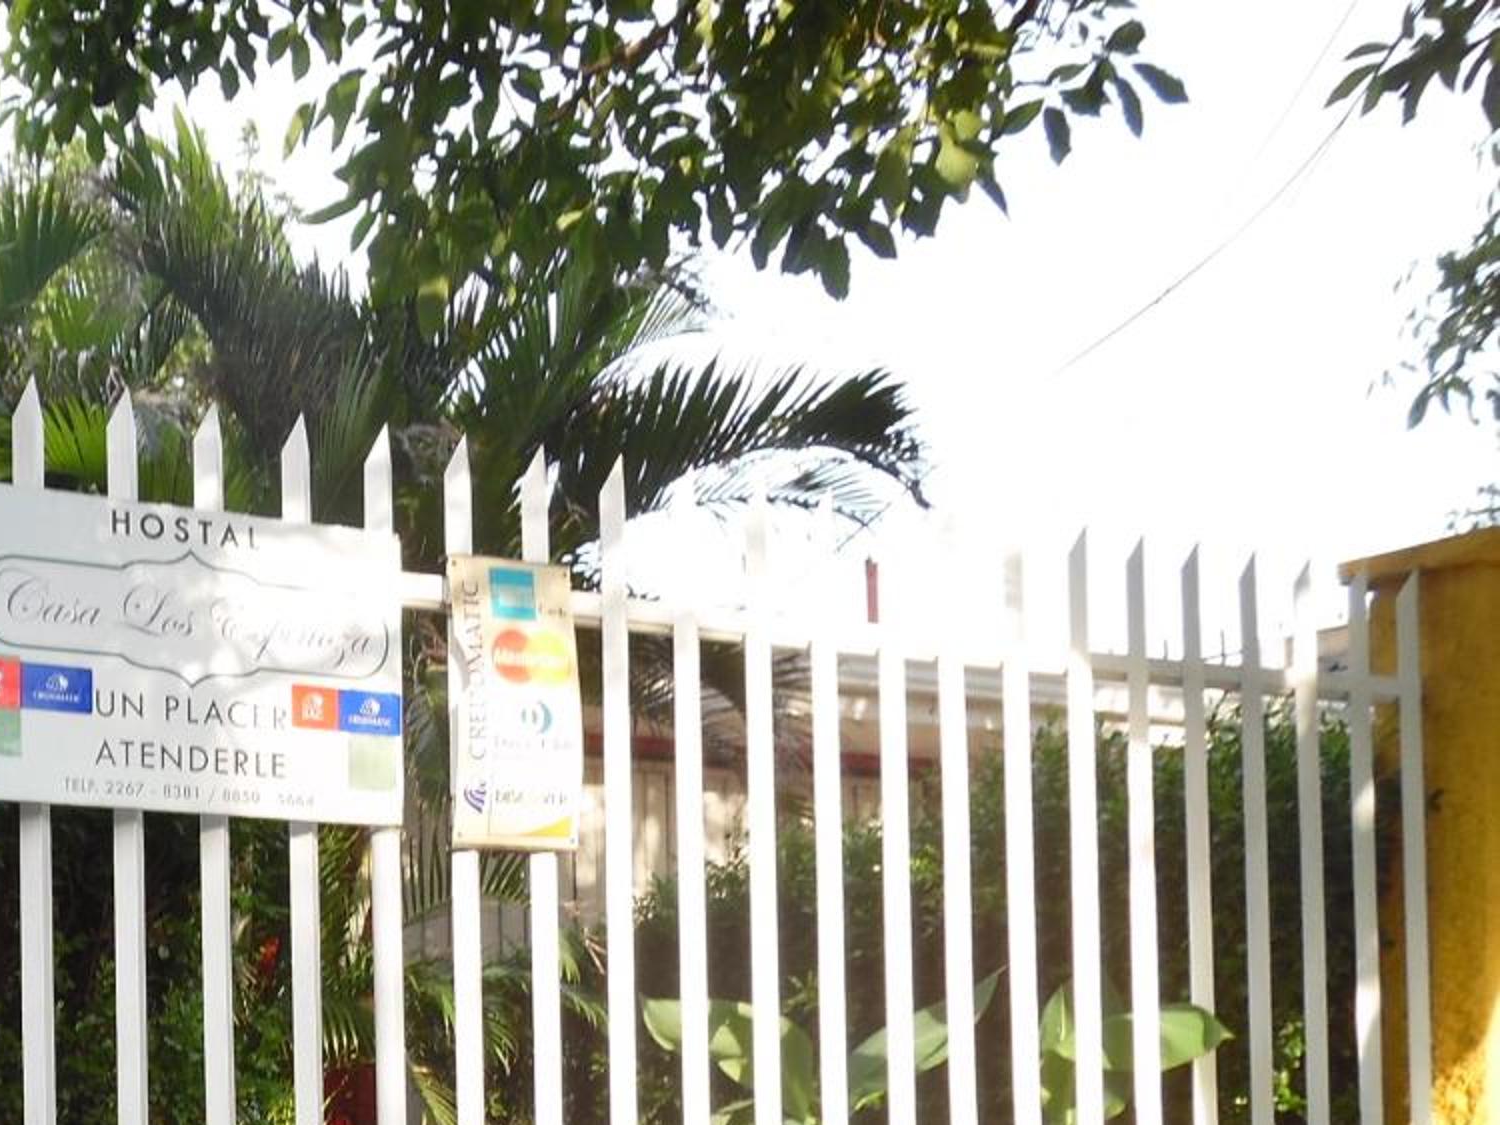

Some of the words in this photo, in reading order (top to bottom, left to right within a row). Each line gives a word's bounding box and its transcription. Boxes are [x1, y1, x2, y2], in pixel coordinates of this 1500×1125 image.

[111, 509, 258, 550] HOSTAL
[123, 584, 194, 637] Los
[95, 688, 144, 718] UN
[94, 738, 286, 779] ATENDERLE
